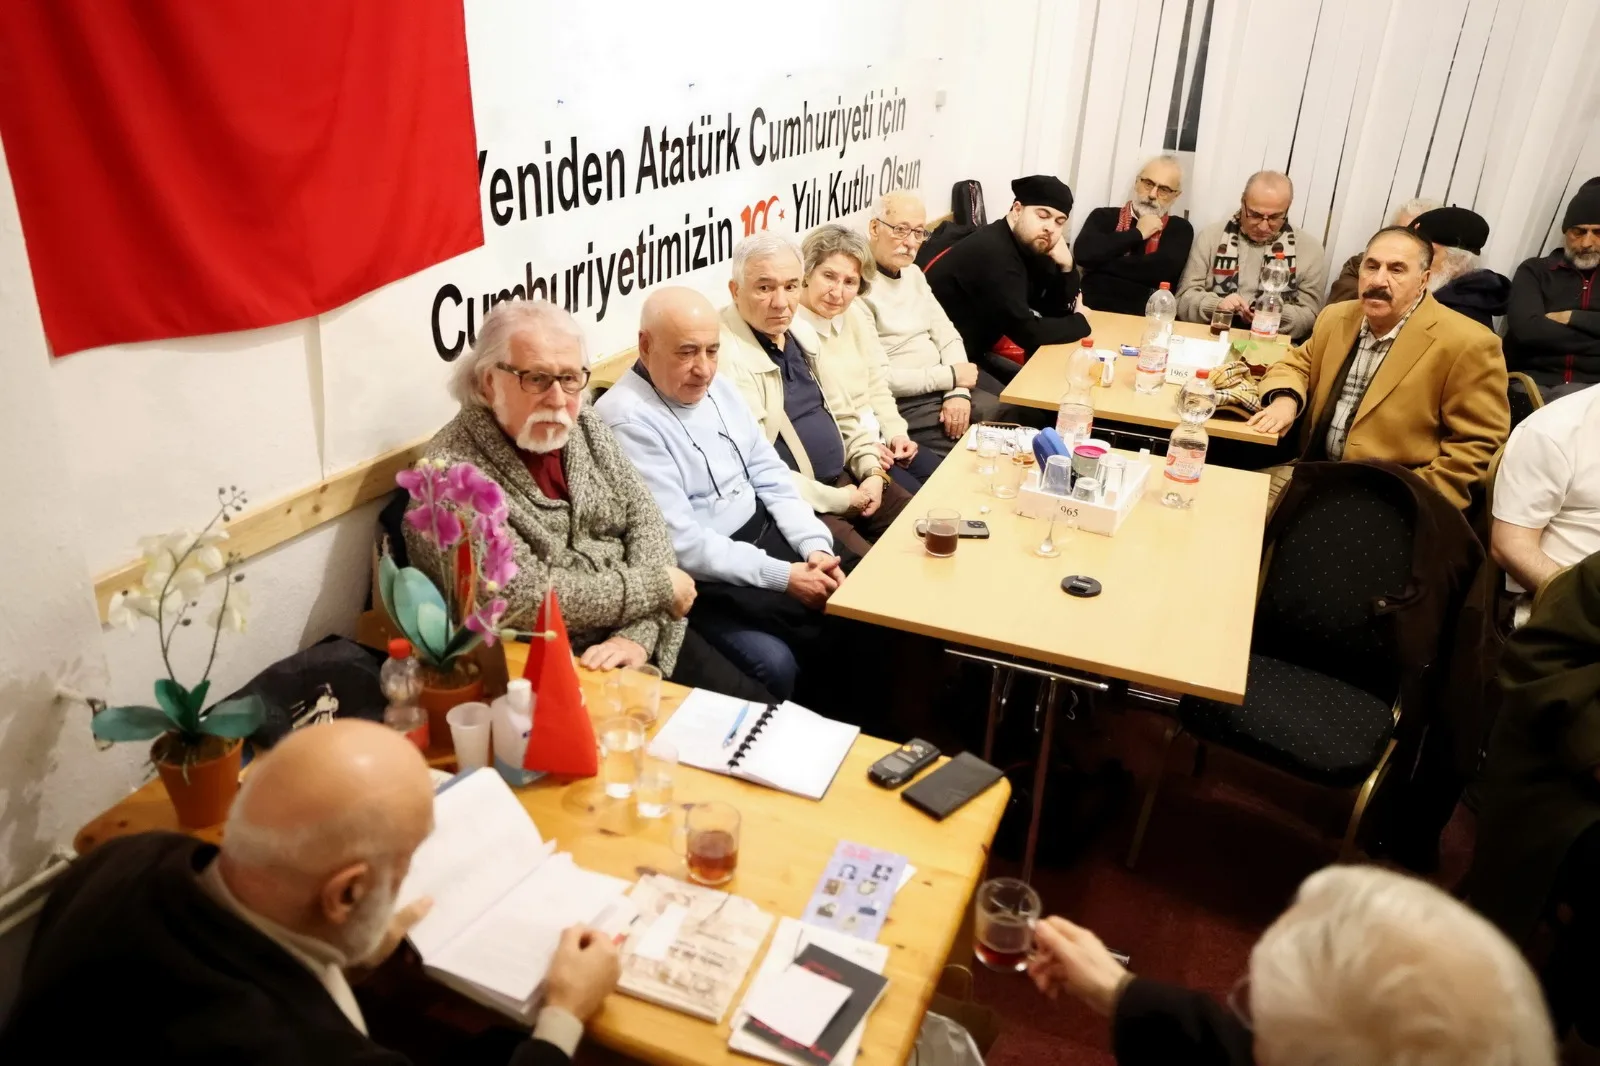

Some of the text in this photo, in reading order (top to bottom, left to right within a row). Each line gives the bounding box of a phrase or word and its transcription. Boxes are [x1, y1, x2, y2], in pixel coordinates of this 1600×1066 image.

[635, 112, 741, 195] Atatürk
[749, 90, 874, 167] Cumhuriyeti
[877, 87, 907, 142] için
[792, 178, 822, 233] Yılı
[827, 164, 875, 222] Kutlu
[879, 155, 921, 197] Olsun
